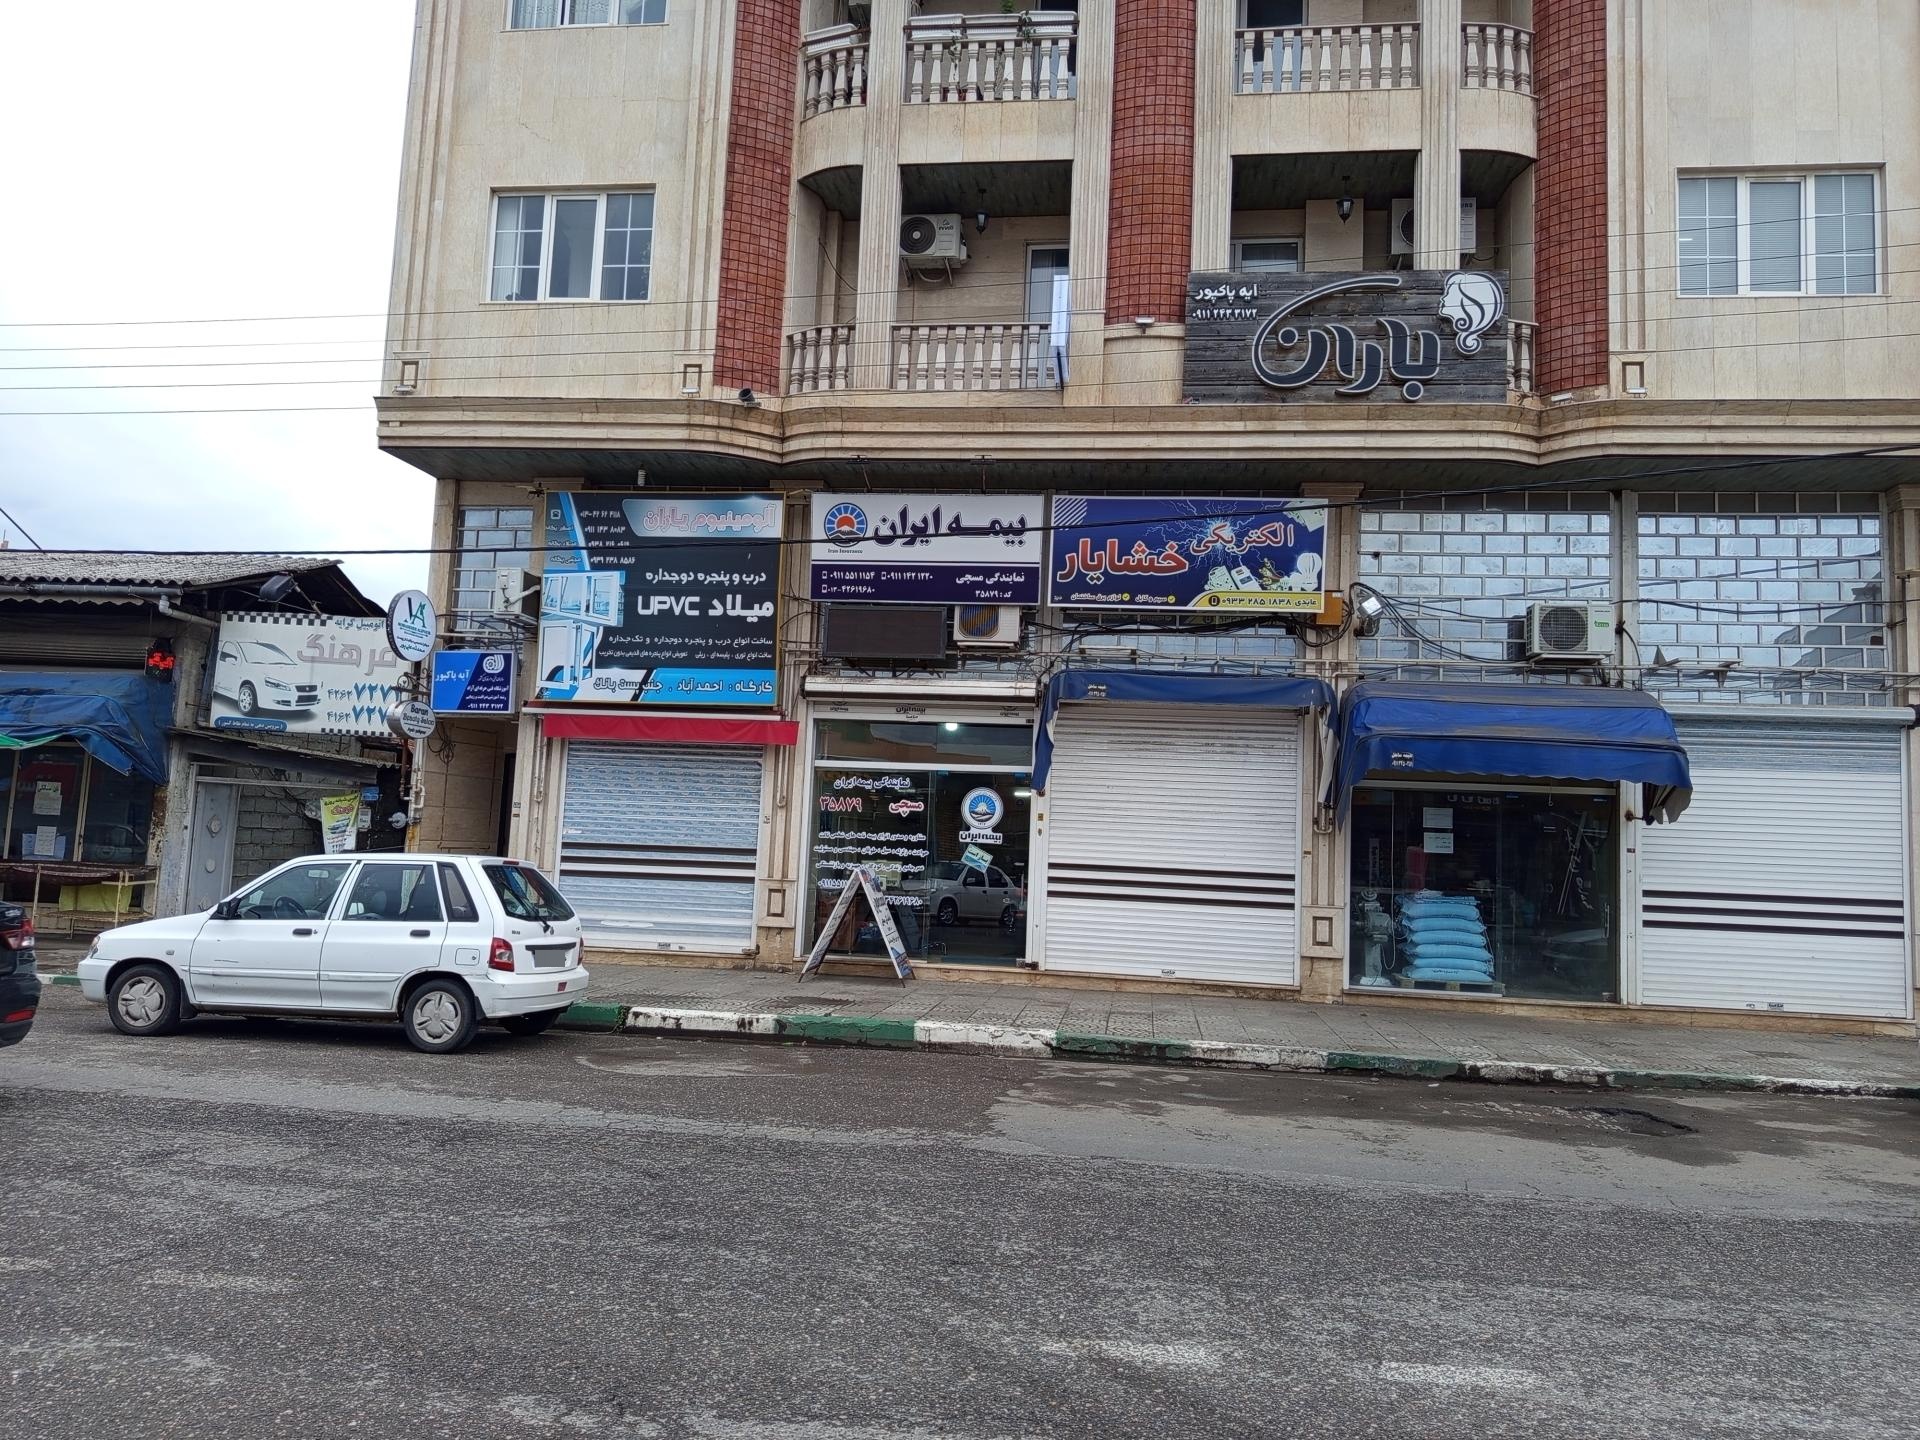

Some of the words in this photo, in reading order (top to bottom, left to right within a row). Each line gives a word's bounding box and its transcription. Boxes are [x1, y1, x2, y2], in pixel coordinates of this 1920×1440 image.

[1194, 283, 1237, 304] پاکپور
[1251, 275, 1441, 403] باران
[690, 503, 776, 533] آلومینیوم
[872, 503, 943, 547] ایران
[946, 510, 1028, 547] بیمه
[1189, 520, 1295, 555] الکتریکی
[1056, 537, 1189, 585] خشایار
[697, 570, 730, 586] پنجره
[732, 573, 740, 585] و
[742, 572, 767, 585] درب
[955, 573, 984, 585] مسچی
[985, 571, 1025, 585] نمایندگی
[975, 590, 999, 598] ۳۵۸۷۹
[638, 595, 701, 616] UPVC
[1221, 597, 1245, 605] ۰۹۳۳
[1294, 598, 1317, 607] عابدی
[708, 594, 775, 623] میلاد
[334, 618, 356, 631] کرایه
[356, 618, 385, 632] اتومبیل
[645, 637, 651, 645] و
[684, 635, 706, 647] پنجره
[707, 638, 713, 646] و
[714, 637, 731, 646] درب
[733, 636, 750, 648] انواع
[751, 637, 773, 645] ساخت
[410, 703, 429, 716] Baran
[834, 776, 857, 789] ایران
[857, 778, 873, 789] بیمه
[873, 776, 911, 789] نمایندگی
[820, 795, 863, 813] ۳۵۸۷۹
[960, 831, 982, 842] ایران
[982, 832, 1002, 844] بیمه
